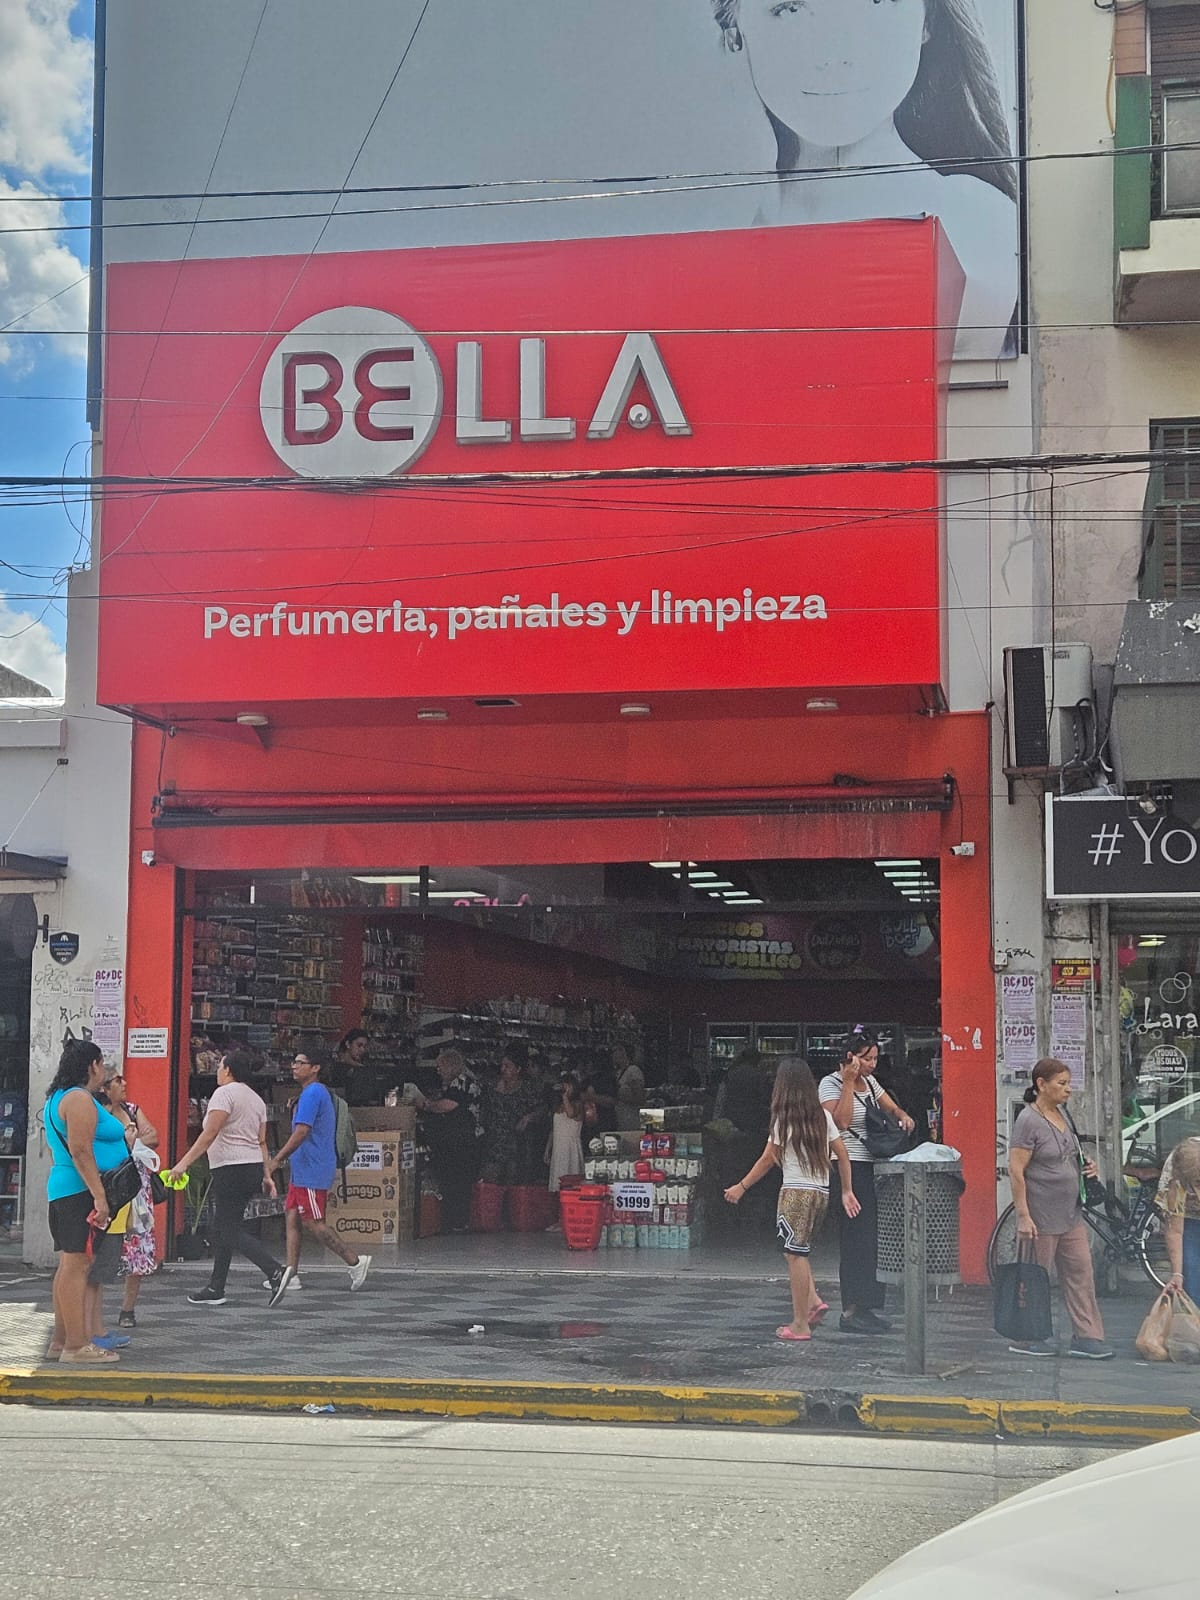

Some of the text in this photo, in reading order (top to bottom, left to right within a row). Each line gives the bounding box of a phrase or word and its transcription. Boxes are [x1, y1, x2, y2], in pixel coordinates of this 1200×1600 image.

[272, 327, 693, 448] BELLA
[448, 593, 607, 640] pañales
[616, 601, 641, 635] y
[651, 587, 828, 632] limpieza
[678, 937, 794, 955] MAYORISTAS
[1143, 996, 1199, 1030] Lara
[616, 1195, 650, 1208] $1999
